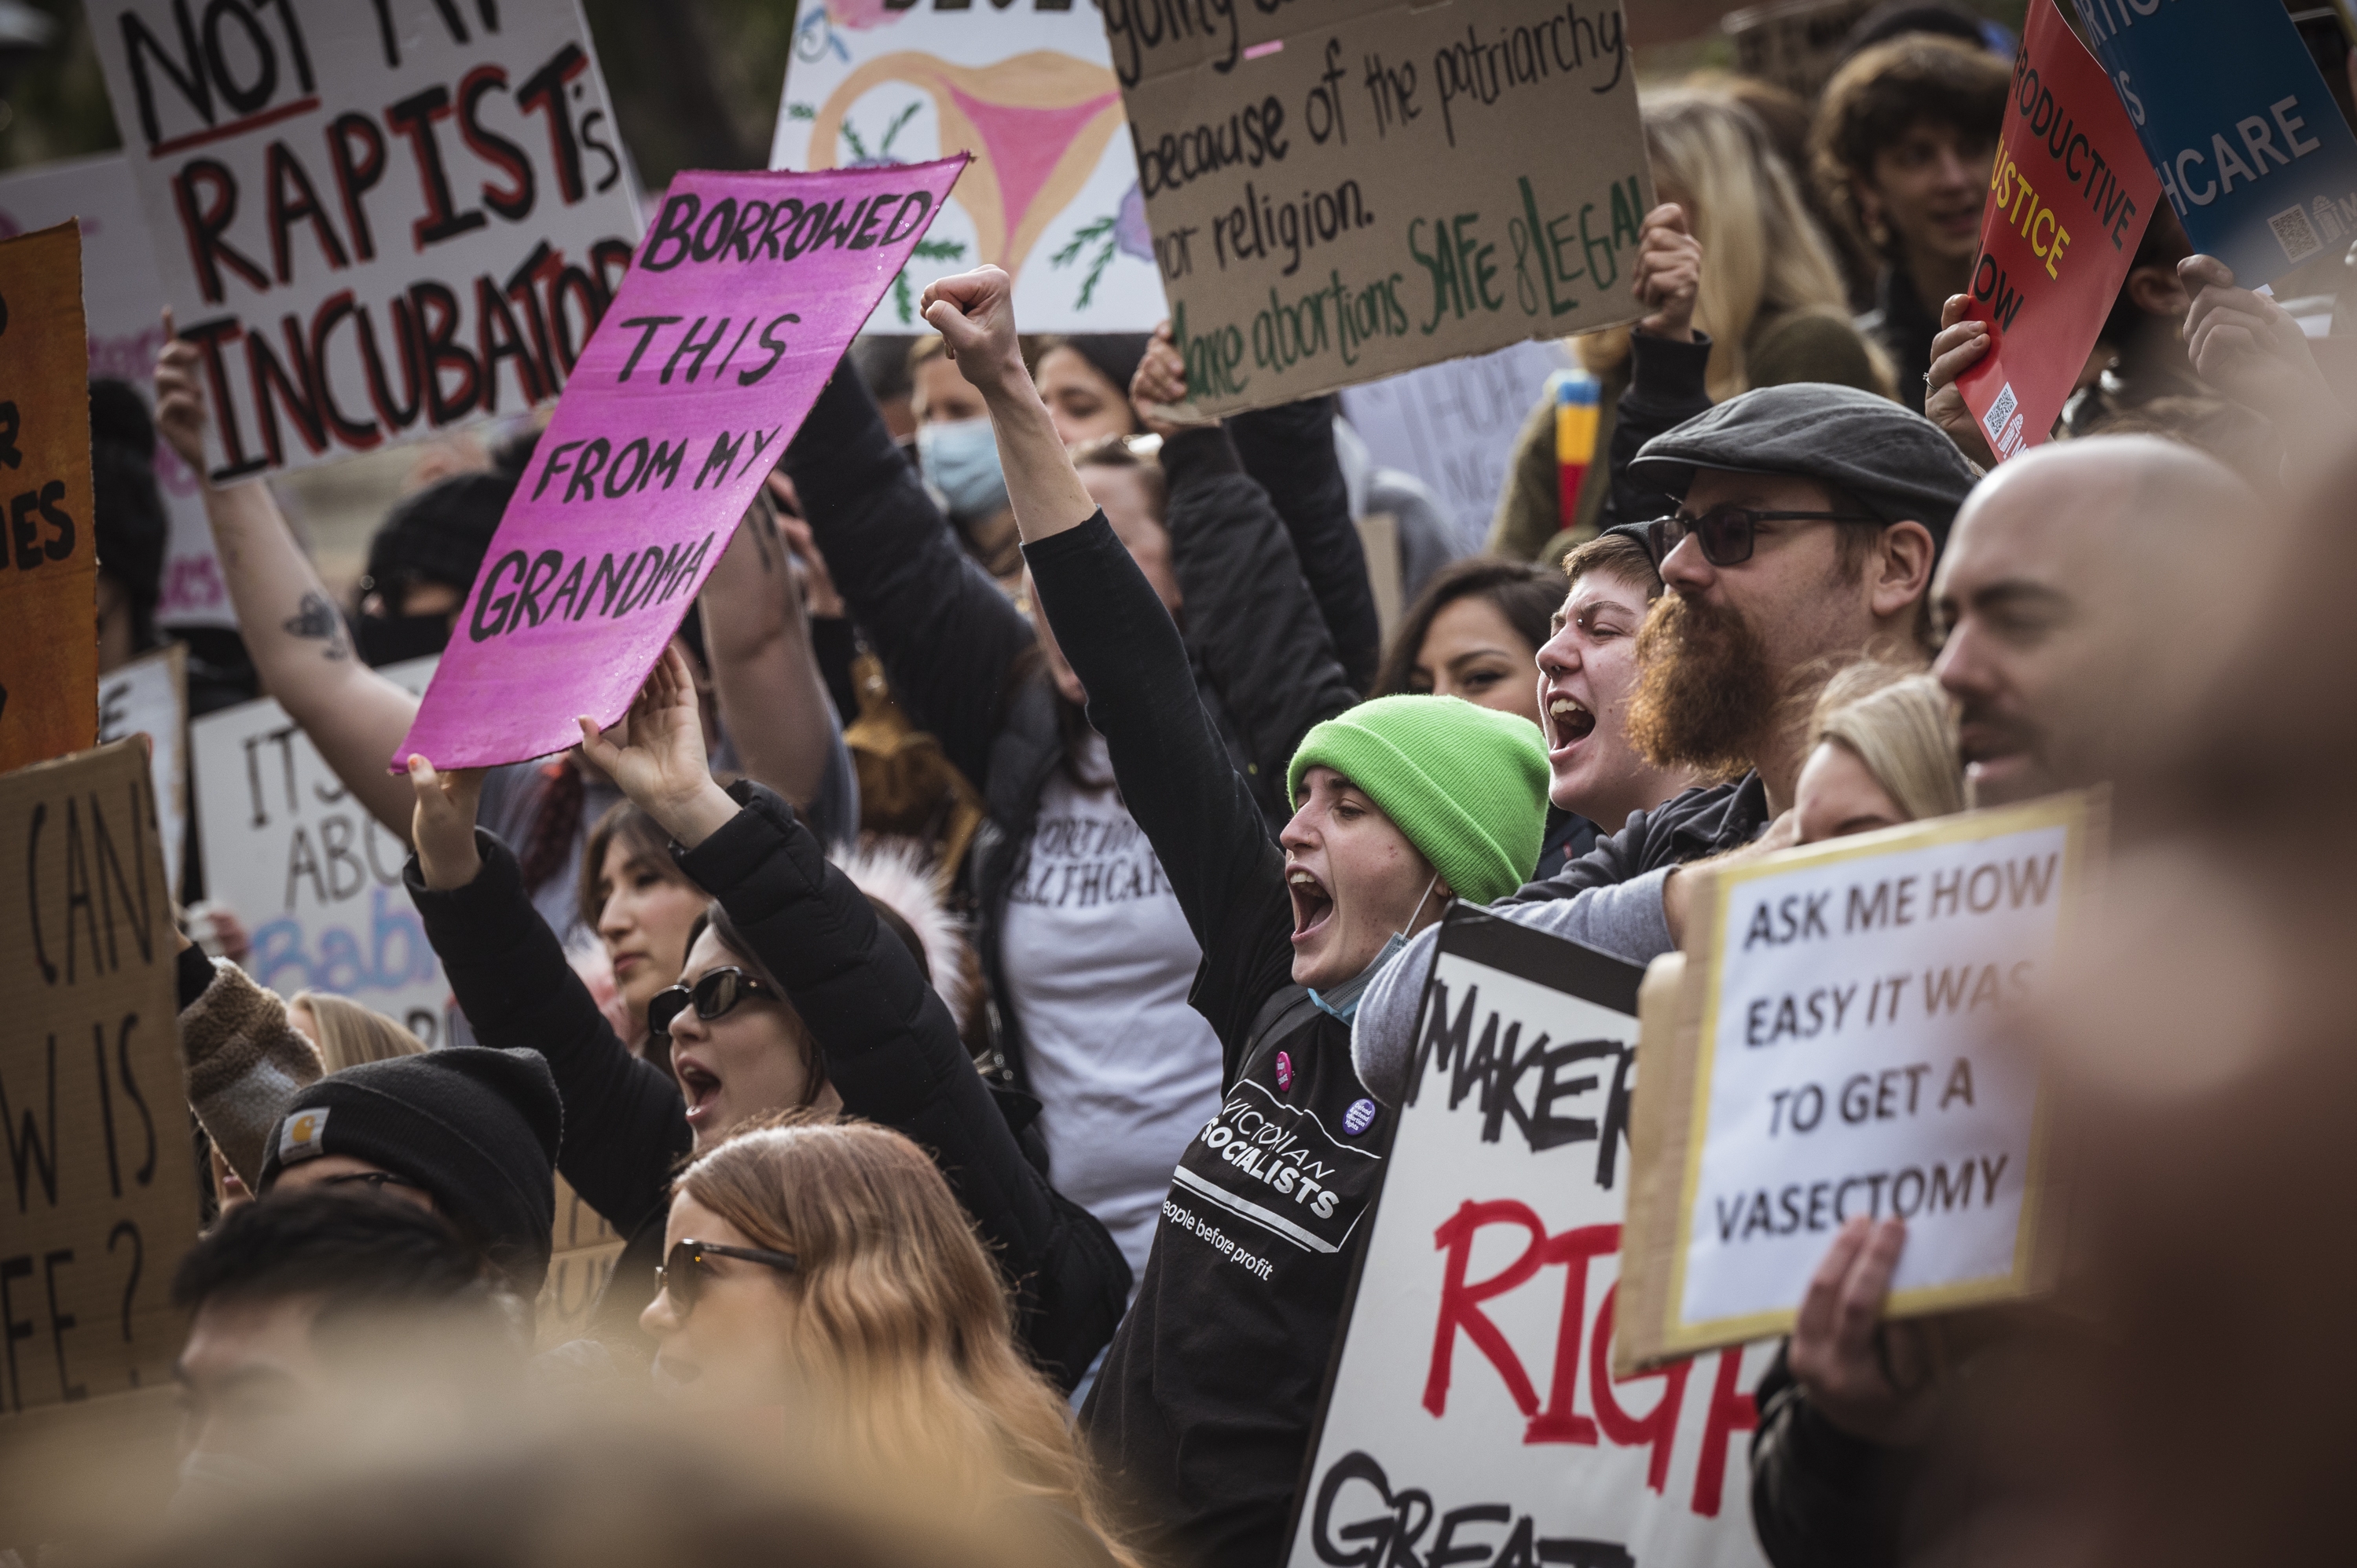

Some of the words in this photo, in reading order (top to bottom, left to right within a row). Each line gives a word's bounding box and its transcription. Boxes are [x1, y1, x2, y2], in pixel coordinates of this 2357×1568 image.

[119, 0, 317, 143] NOT
[1129, 94, 1289, 199] because
[1306, 38, 1347, 145] of
[1365, 52, 1421, 140] the
[1434, 3, 1624, 148] patriarchy
[2014, 35, 2137, 252] RODUCTIVE
[639, 191, 933, 273] BORROWED
[1211, 179, 1374, 276] religion.
[1991, 131, 2055, 281] USTICE
[1251, 267, 1409, 374] abortions
[1407, 211, 1505, 335] SAFE
[1973, 240, 2024, 334] OW
[618, 313, 801, 387] THIS
[531, 437, 689, 504] FROM
[693, 425, 783, 491] MY
[469, 531, 716, 643] GRANDMA
[1743, 889, 1832, 951] ASK
[1844, 874, 1918, 932] ME
[1930, 852, 2061, 918] HOW
[1745, 980, 1858, 1049] EASY
[1866, 973, 1912, 1028] IT
[1923, 959, 2034, 1017] WAS
[92, 1011, 158, 1199] IS
[1222, 1097, 1336, 1179] VICTORIAN
[1344, 1119, 1359, 1131] rights
[1346, 1113, 1365, 1127] abortion
[1353, 1109, 1370, 1123] extend
[1354, 1101, 1373, 1116] Defend
[1769, 1084, 1824, 1138] TO
[1839, 1062, 1931, 1126] GET
[1941, 1057, 1976, 1110] A
[1200, 1117, 1340, 1219] SOCIALISTS
[1715, 1152, 2009, 1244] VASECTOMY
[1194, 1218, 1237, 1255] before
[1230, 1247, 1274, 1281] profit
